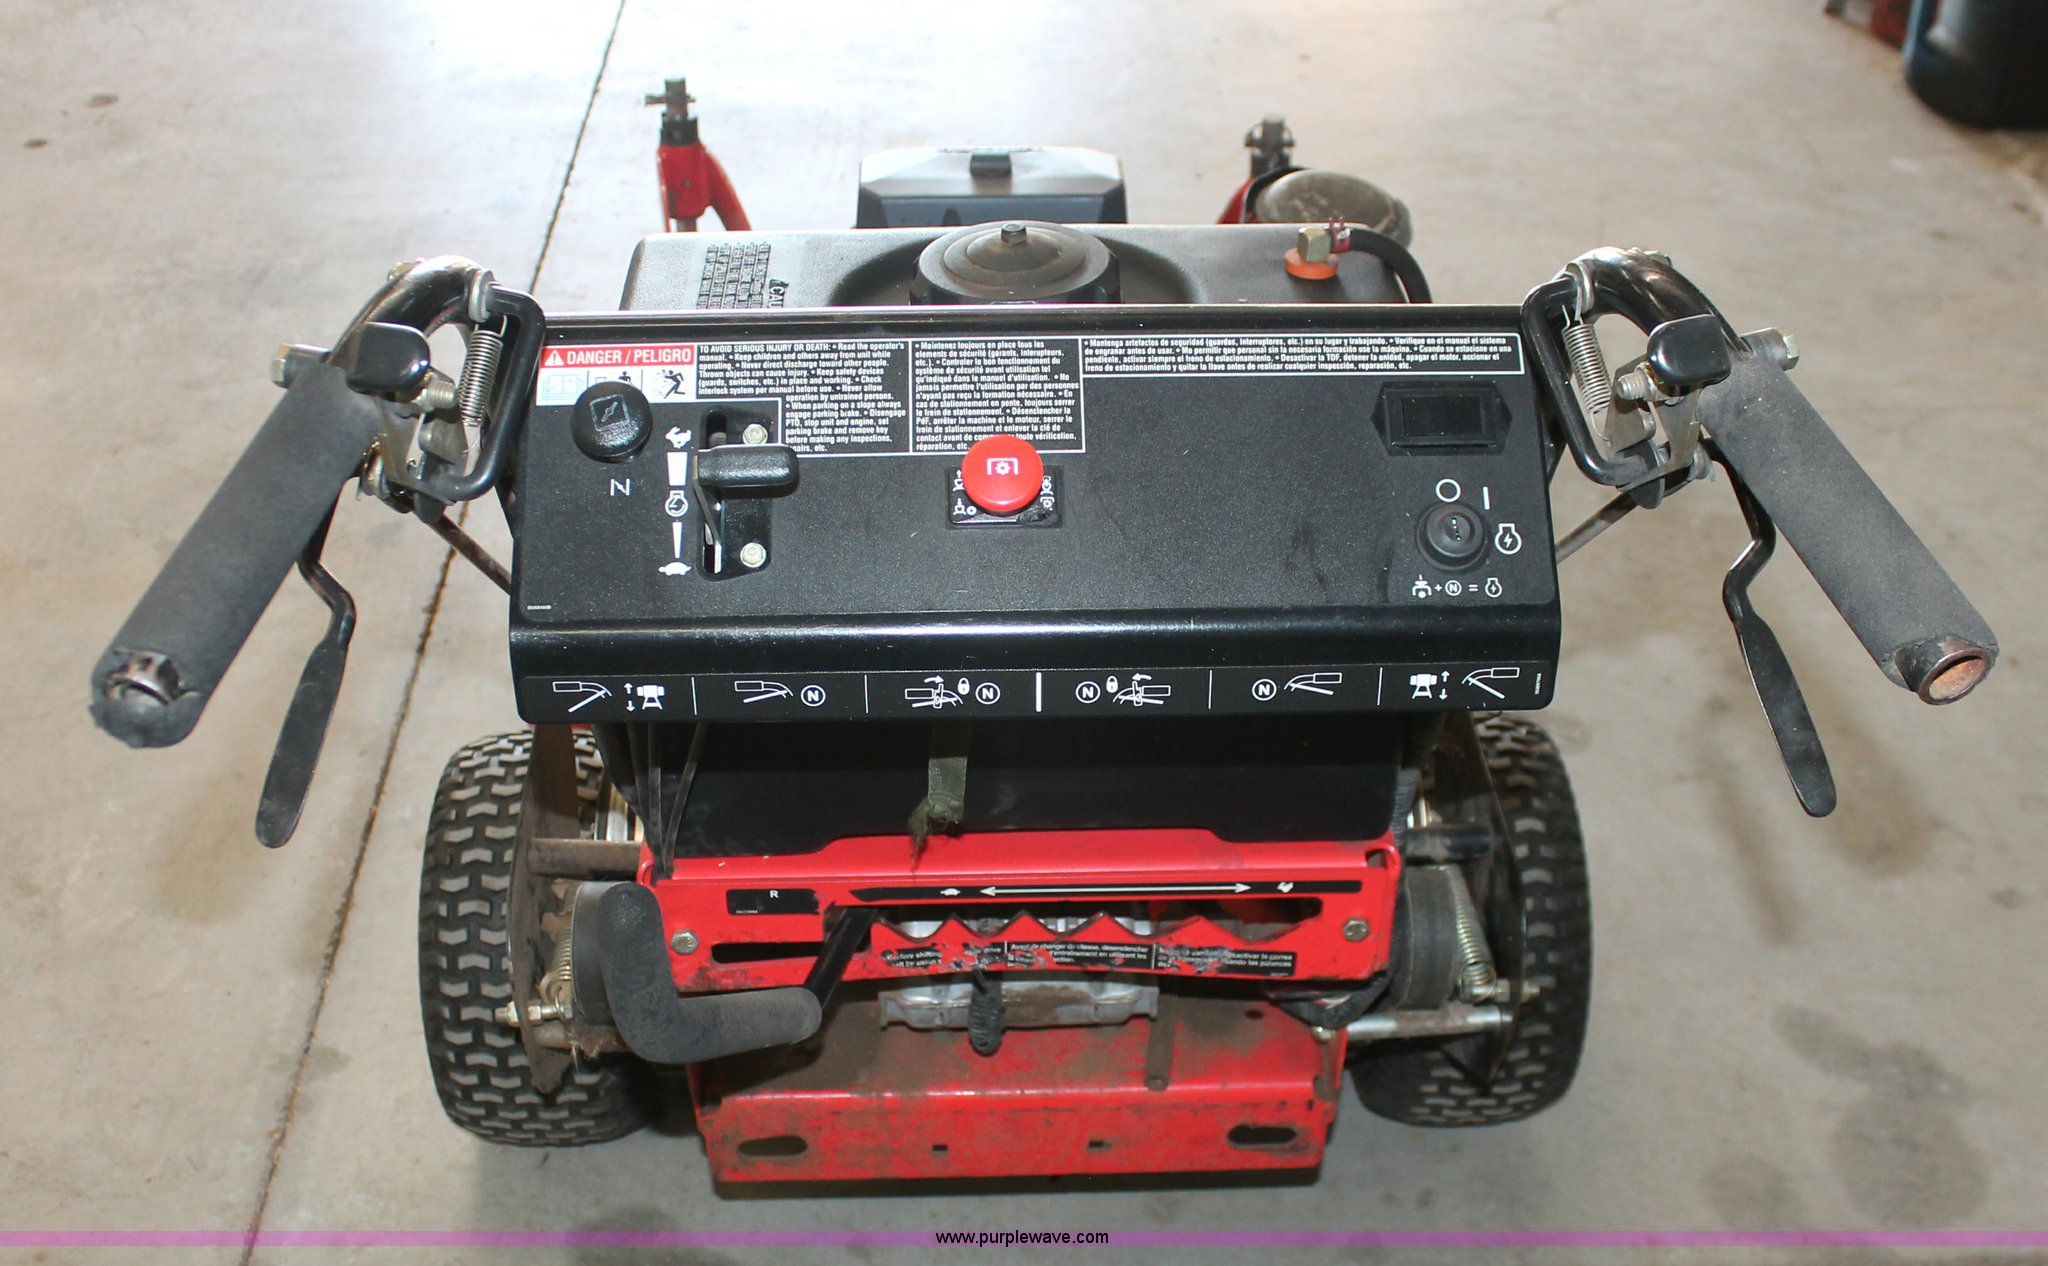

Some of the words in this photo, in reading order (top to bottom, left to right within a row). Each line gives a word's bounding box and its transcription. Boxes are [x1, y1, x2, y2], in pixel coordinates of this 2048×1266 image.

[710, 345, 731, 353] AVOID
[766, 344, 791, 352] INJURY
[567, 350, 622, 365] DANGER
[633, 348, 692, 363] PELIGRO
[734, 353, 751, 361] Keep
[753, 352, 781, 360] children
[872, 350, 891, 358] while
[784, 360, 816, 369] discharge
[725, 370, 750, 378] objects
[816, 368, 833, 377] Keep
[836, 368, 856, 377] safety
[763, 377, 778, 386] etc.)
[789, 377, 807, 386] place
[730, 386, 753, 395] system
[768, 385, 794, 393] manual
[786, 393, 818, 402] operation
[820, 393, 828, 402] by
[813, 402, 838, 410] parking
[857, 401, 875, 410] slope
[877, 401, 901, 410] always
[813, 410, 838, 419] parking
[804, 418, 819, 427] stop
[785, 427, 811, 436] parking
[876, 426, 888, 435] key
[809, 435, 834, 444] making
[836, 436, 848, 444] any
[769, 890, 779, 898] R
